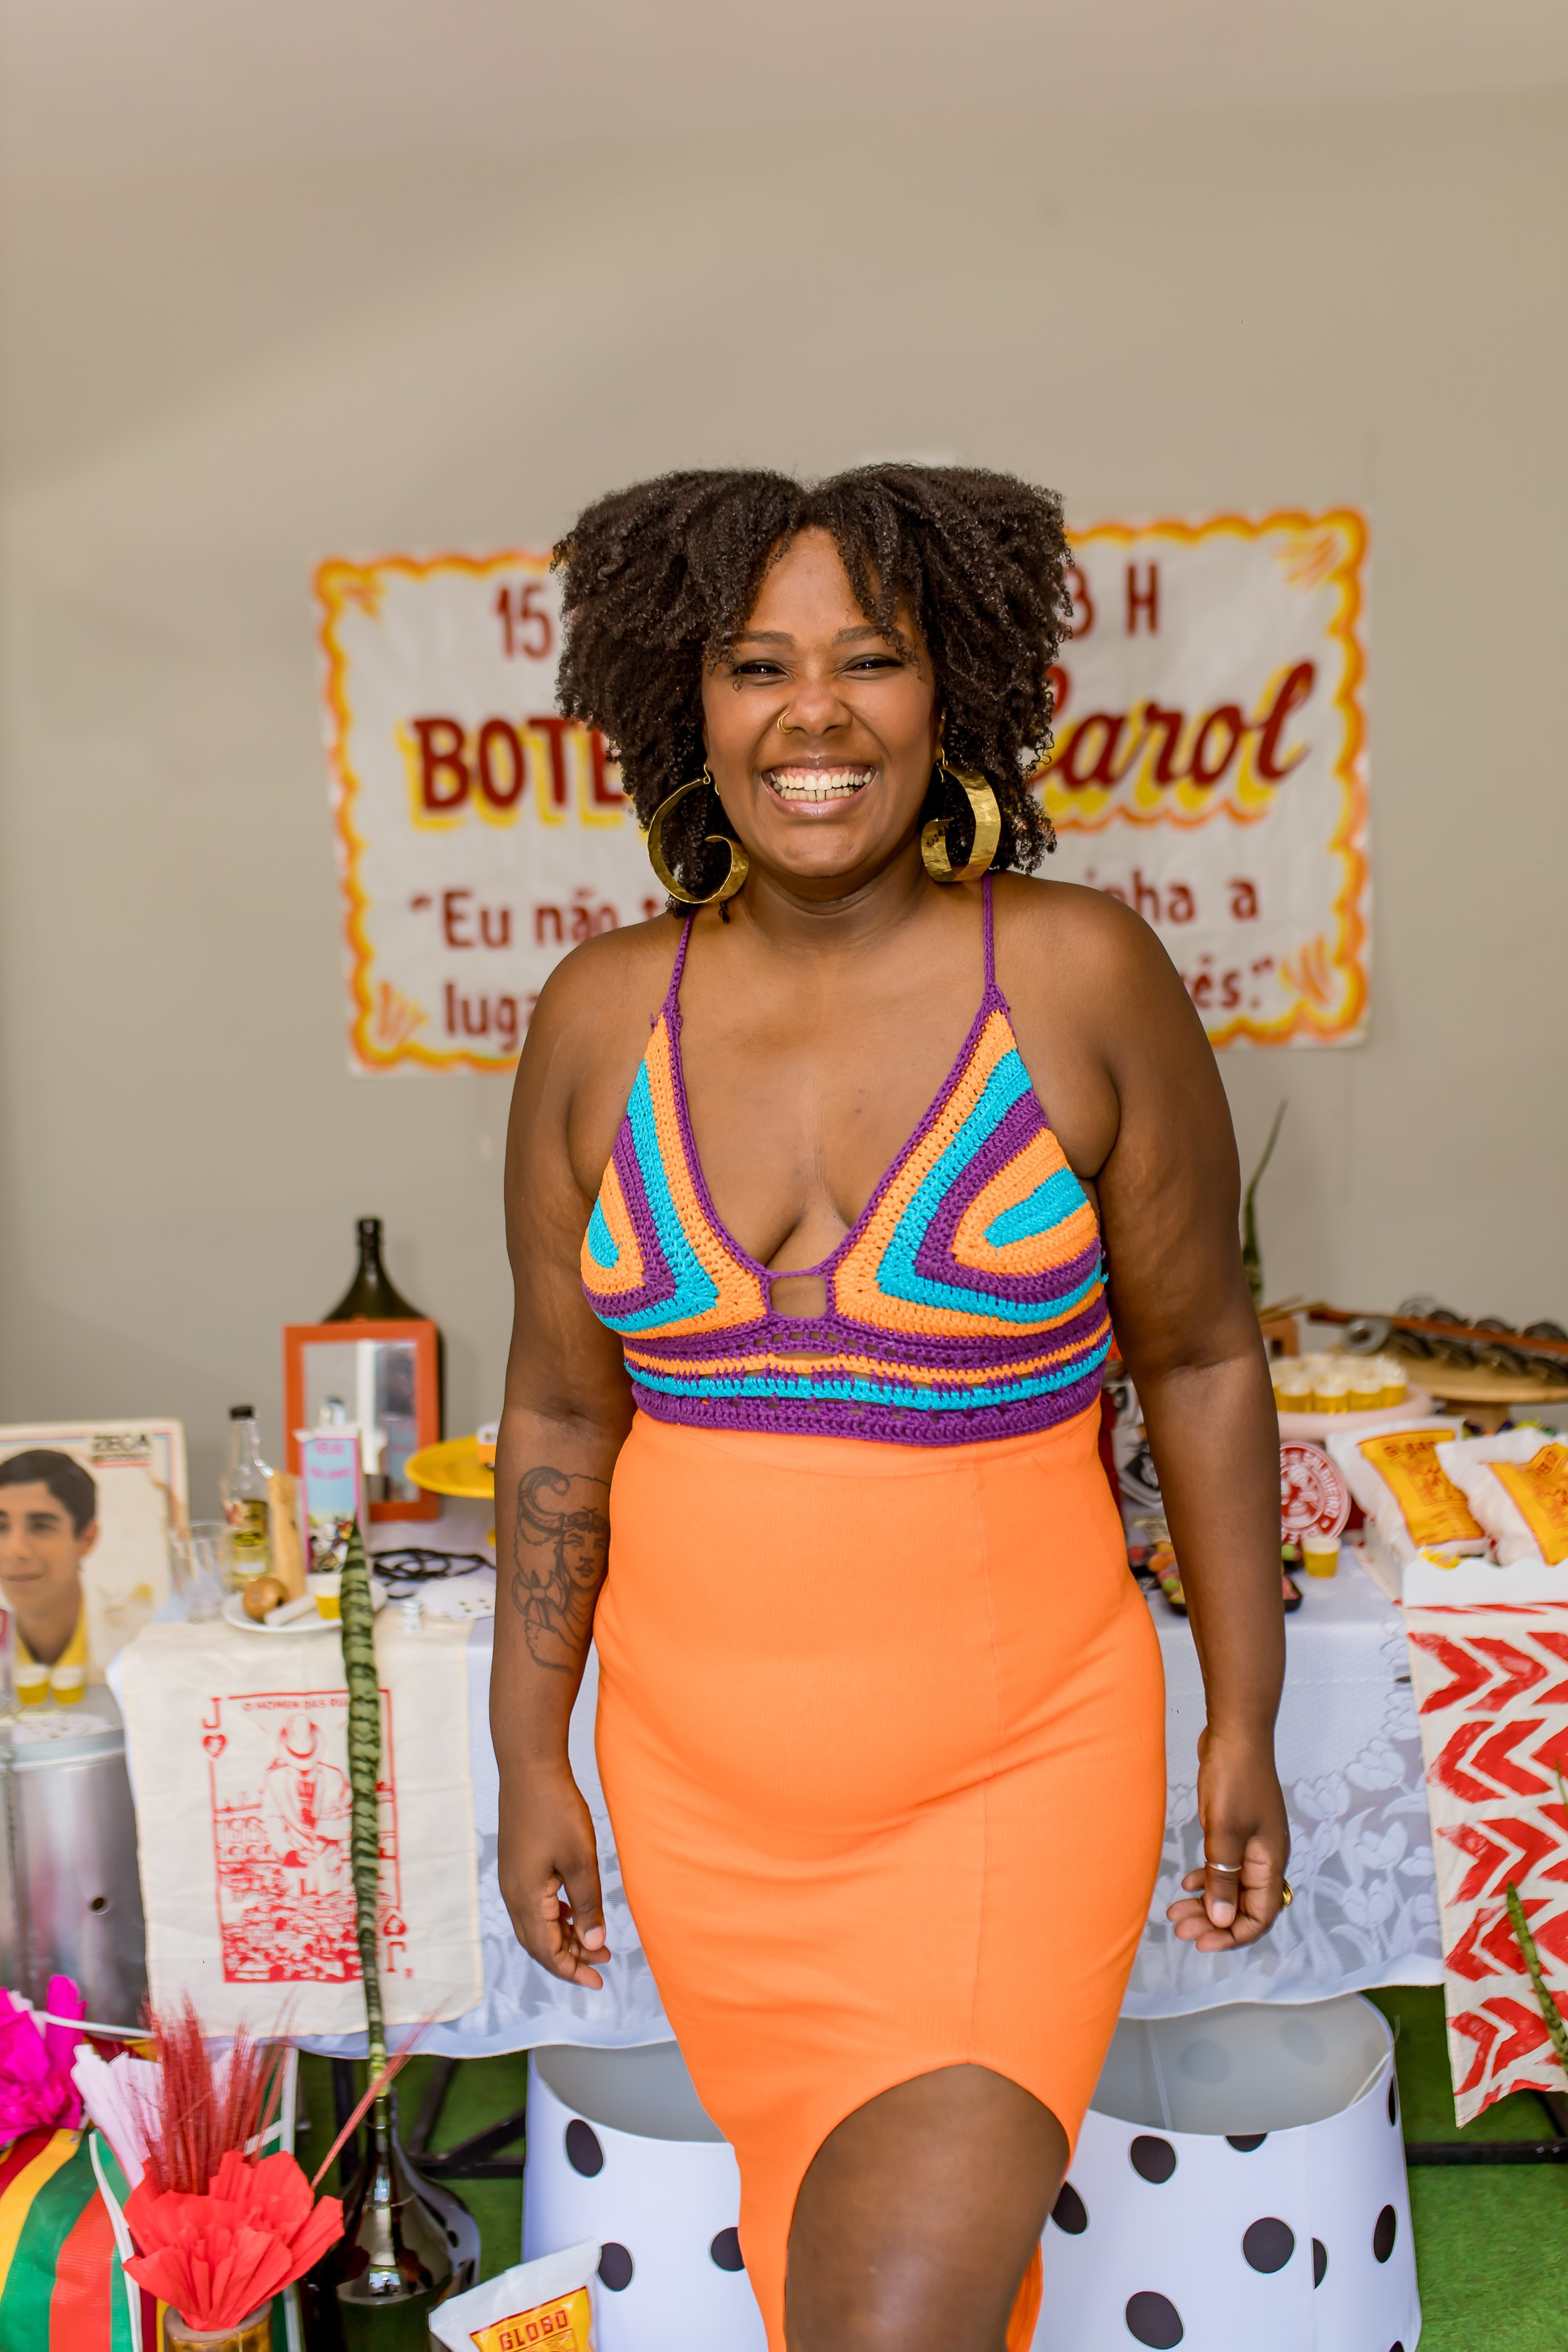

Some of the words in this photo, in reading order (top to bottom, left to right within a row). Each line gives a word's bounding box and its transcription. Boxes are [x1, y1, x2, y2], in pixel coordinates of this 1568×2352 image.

[496, 585, 553, 658] 15
[1124, 562, 1159, 634] H
[1231, 880, 1259, 922] a
[445, 982, 538, 1051] lug
[498, 2309, 568, 2351] GLOBO
